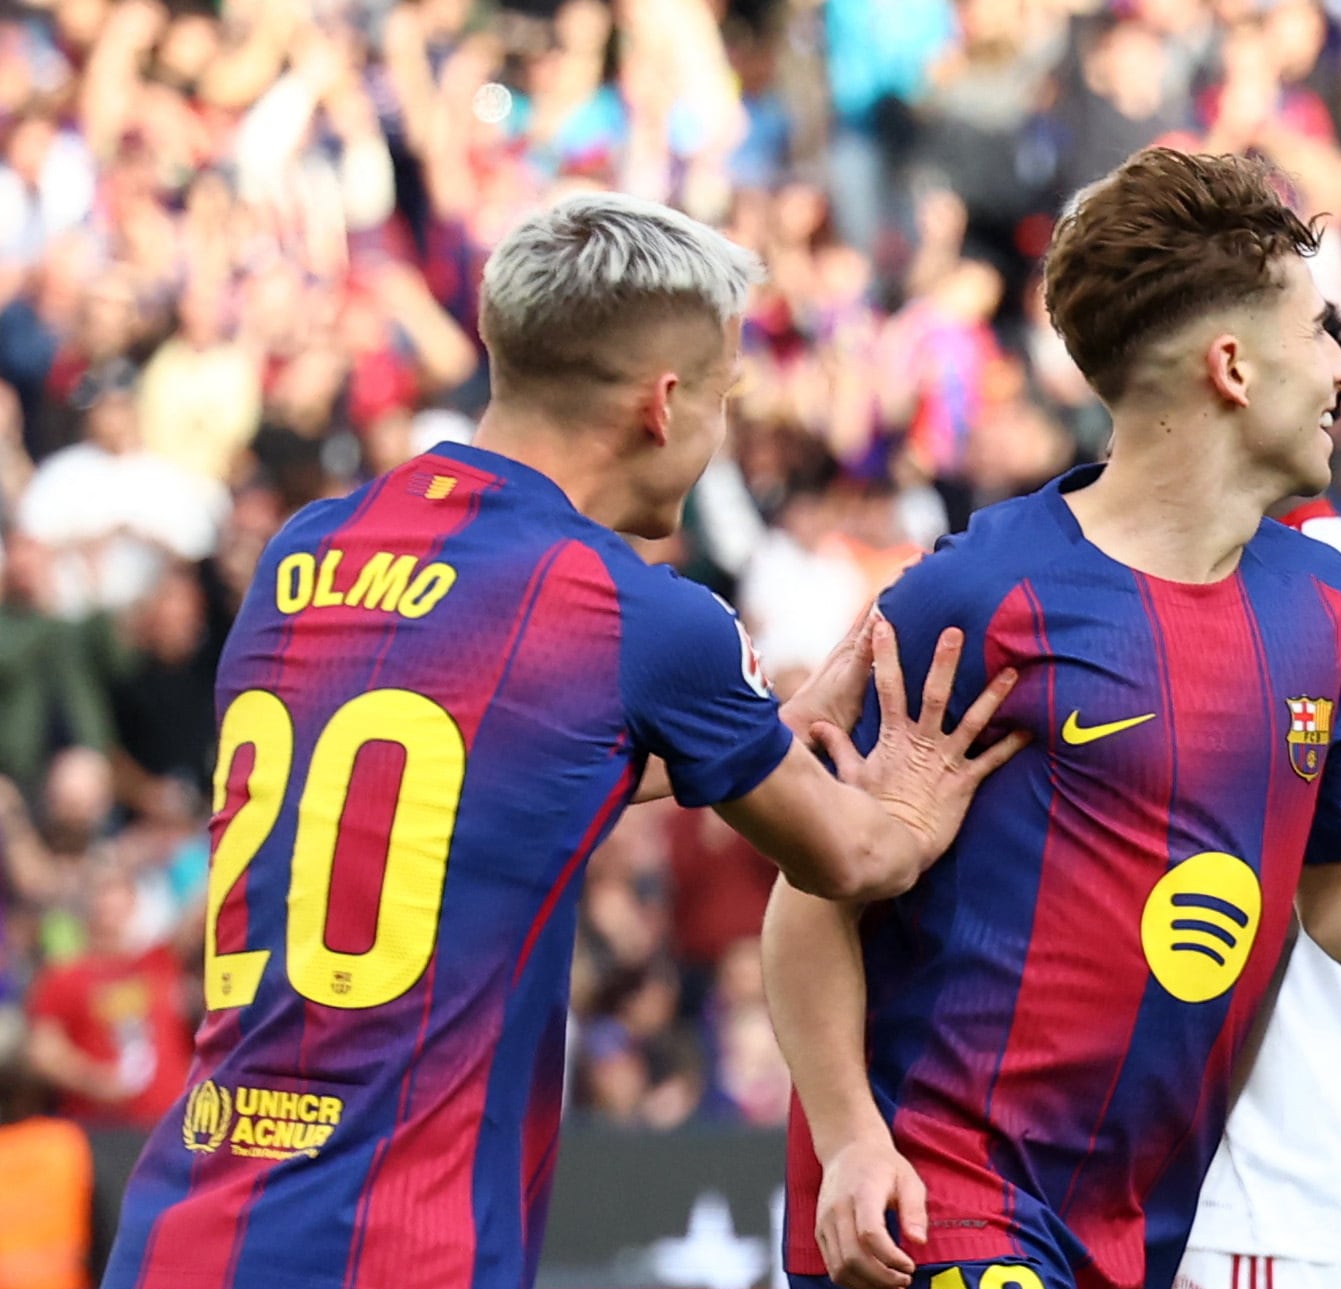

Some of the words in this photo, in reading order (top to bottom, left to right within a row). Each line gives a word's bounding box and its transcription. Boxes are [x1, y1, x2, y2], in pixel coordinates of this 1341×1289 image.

[276, 549, 457, 619] OLMO
[205, 688, 467, 1011] 20
[230, 1116, 334, 1149] ACNUR
[235, 1087, 343, 1125] UNHCR
